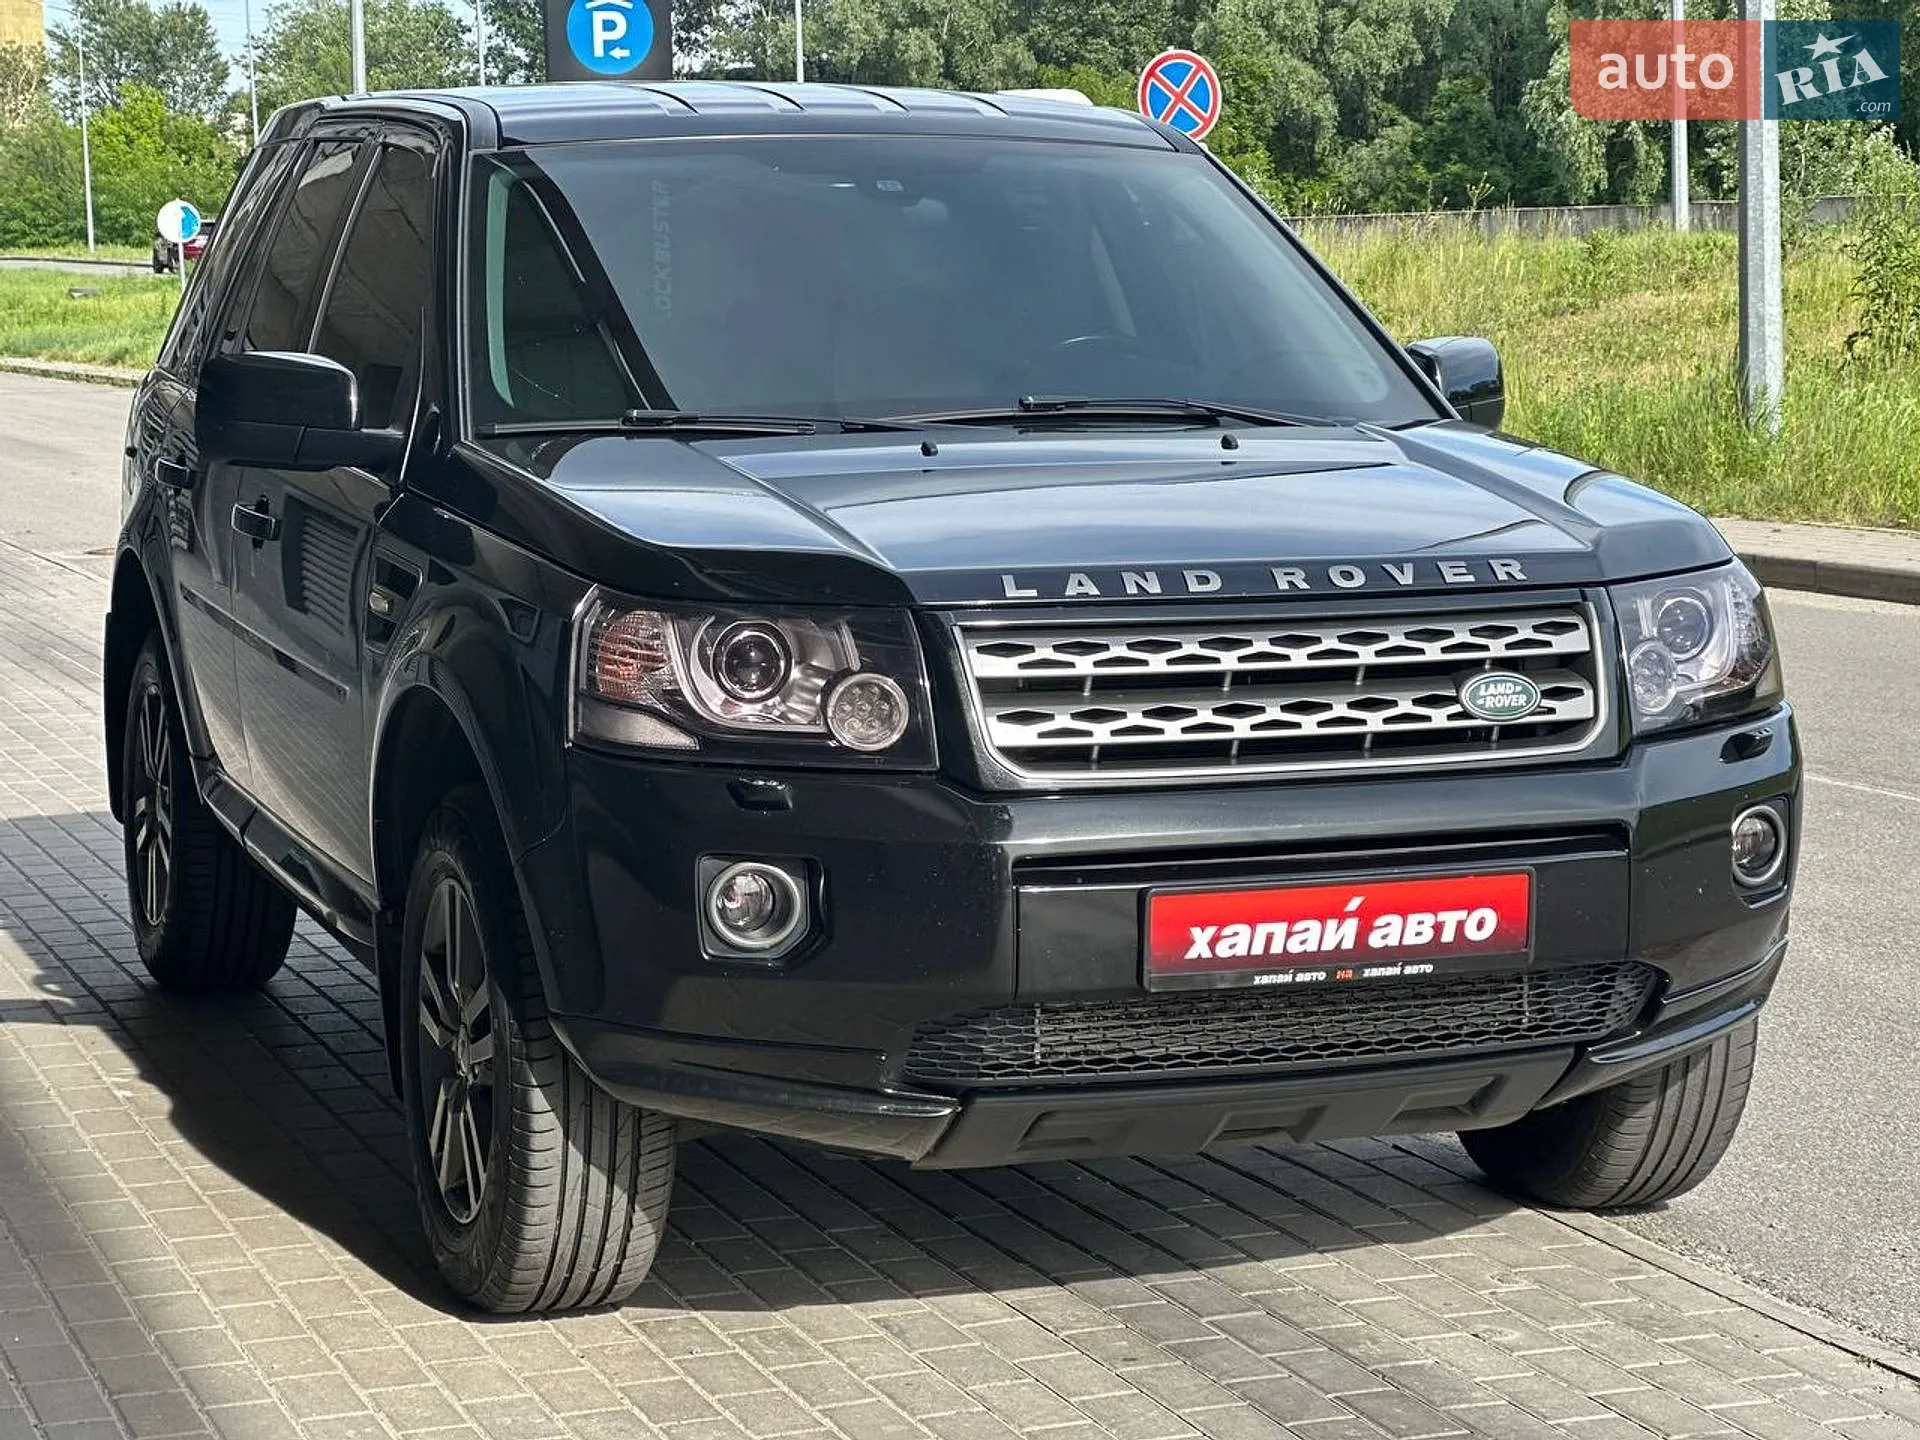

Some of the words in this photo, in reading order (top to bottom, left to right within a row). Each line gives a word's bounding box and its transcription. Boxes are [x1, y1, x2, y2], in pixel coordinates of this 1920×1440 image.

[592, 10, 627, 58] P
[1001, 569, 1223, 598] LAND
[1270, 557, 1529, 592] ROVER
[1479, 682, 1515, 696] LAND
[1485, 694, 1527, 708] ROVER
[1368, 906, 1498, 947] авто
